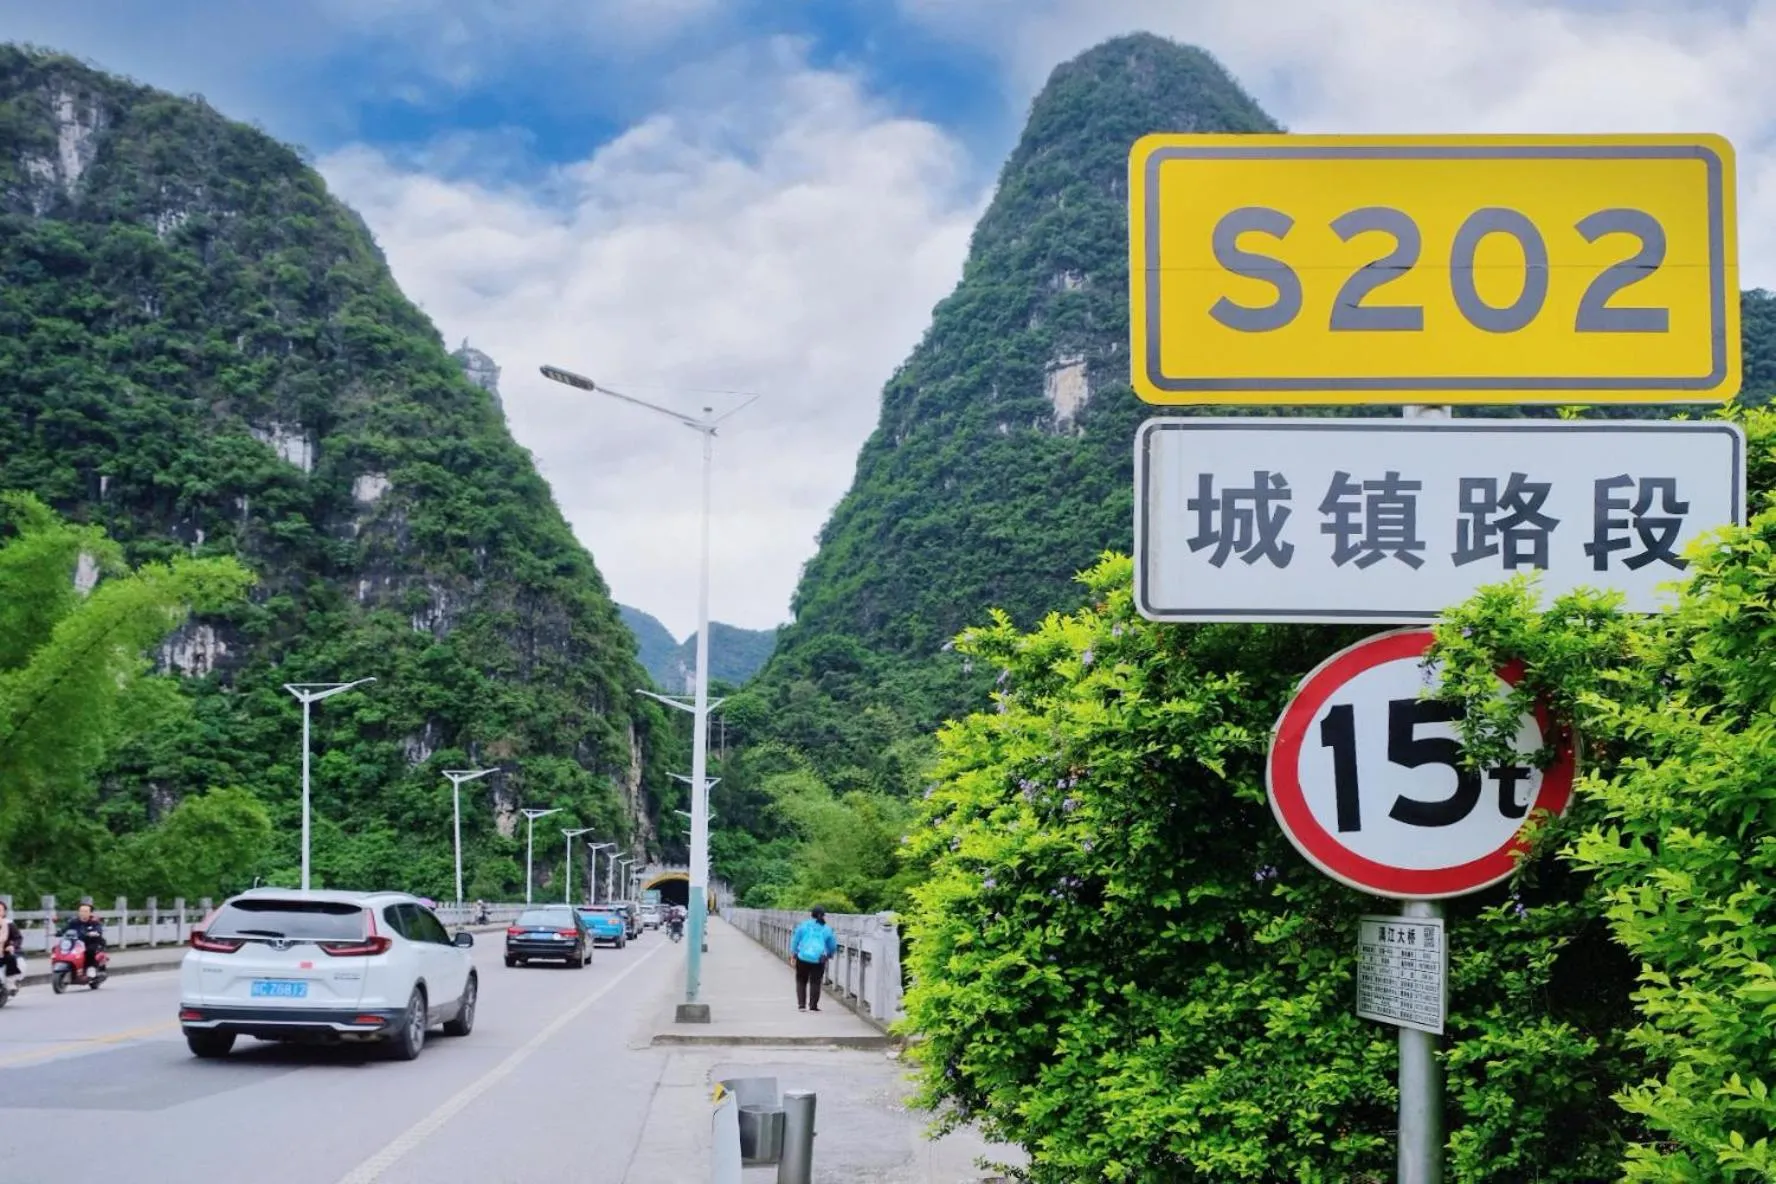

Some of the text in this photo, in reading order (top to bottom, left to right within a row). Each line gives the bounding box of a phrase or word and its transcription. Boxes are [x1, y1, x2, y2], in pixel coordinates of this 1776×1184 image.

[1208, 206, 1670, 333] S202
[1186, 470, 1691, 572] 城镇路段
